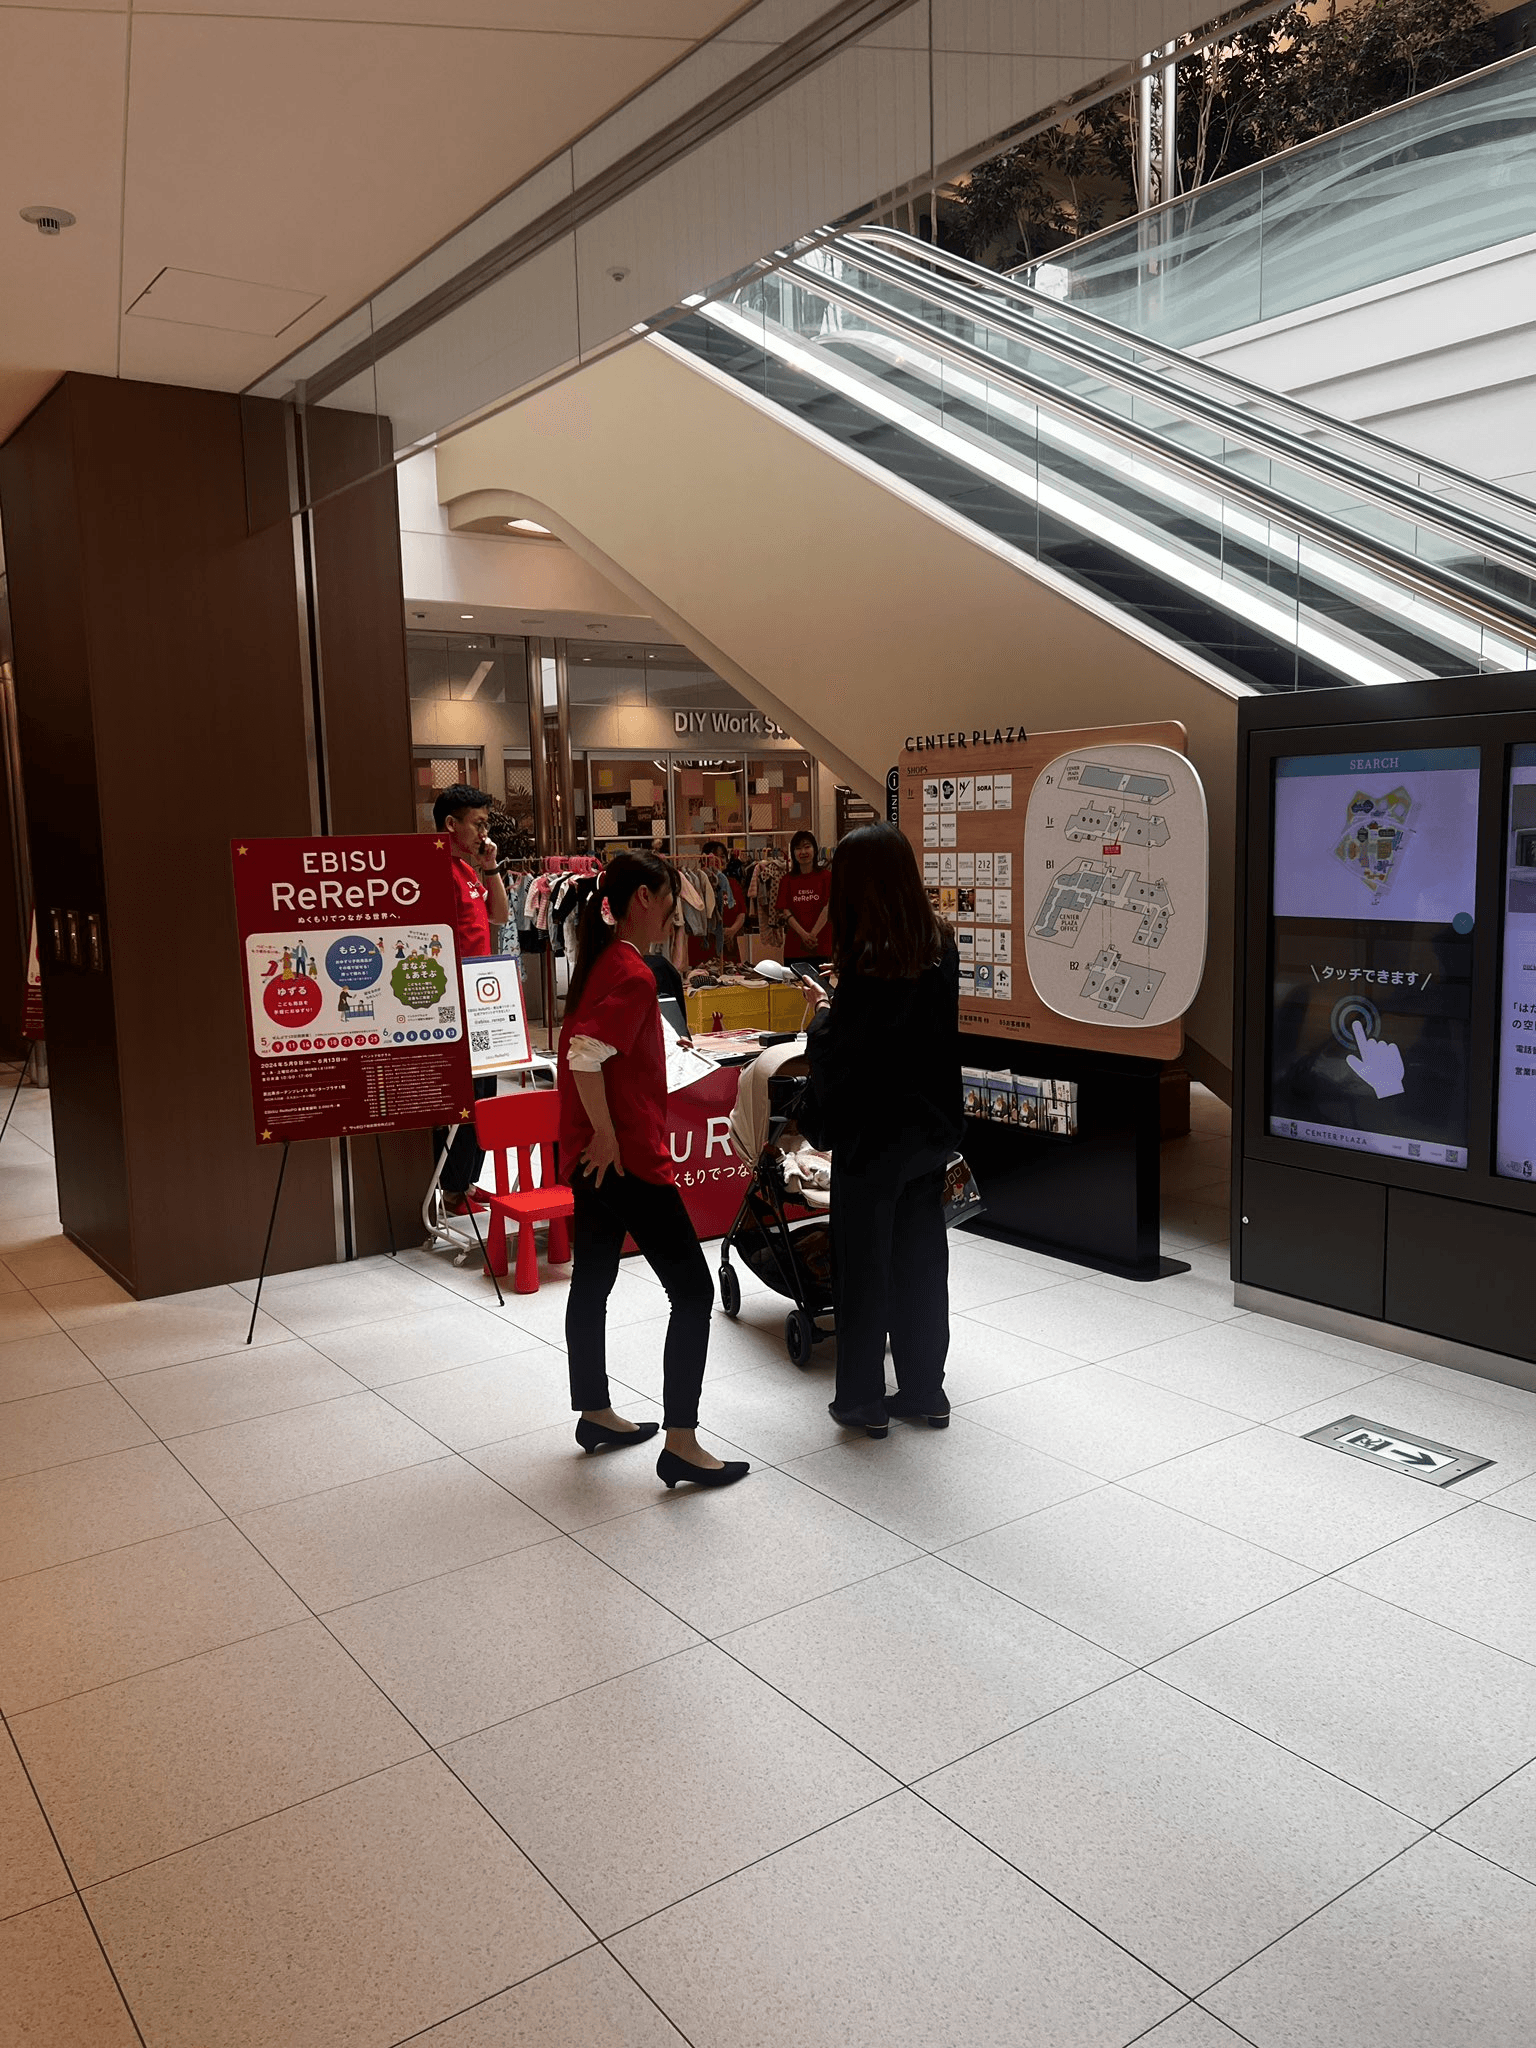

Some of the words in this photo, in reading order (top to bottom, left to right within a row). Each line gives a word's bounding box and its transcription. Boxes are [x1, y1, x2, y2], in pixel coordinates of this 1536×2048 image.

[675, 712, 706, 732] DIY
[712, 712, 760, 733] Work
[905, 732, 967, 751] CENTER
[973, 726, 1027, 746] PLAZA
[1350, 757, 1399, 770] SEARCH
[907, 766, 928, 774] SHOPS
[1046, 775, 1054, 784] 2F
[1047, 816, 1054, 825] 1F
[303, 850, 386, 874] EBISU
[978, 860, 990, 868] 212
[1046, 860, 1054, 869] B1
[272, 877, 421, 911] ReRePO
[298, 912, 401, 924] ぬくもりでつながる世界へ。
[340, 945, 366, 954] もらう
[401, 962, 428, 970] まなぶ
[1070, 961, 1079, 970] B2
[1322, 966, 1419, 986] タッチできます
[277, 986, 307, 996] ゆずる
[1512, 1020, 1536, 1031] の空
[383, 1028, 388, 1036] 6
[261, 1038, 267, 1046] 5
[1305, 1128, 1338, 1141] CENTER
[1340, 1134, 1367, 1145] PLAZA
